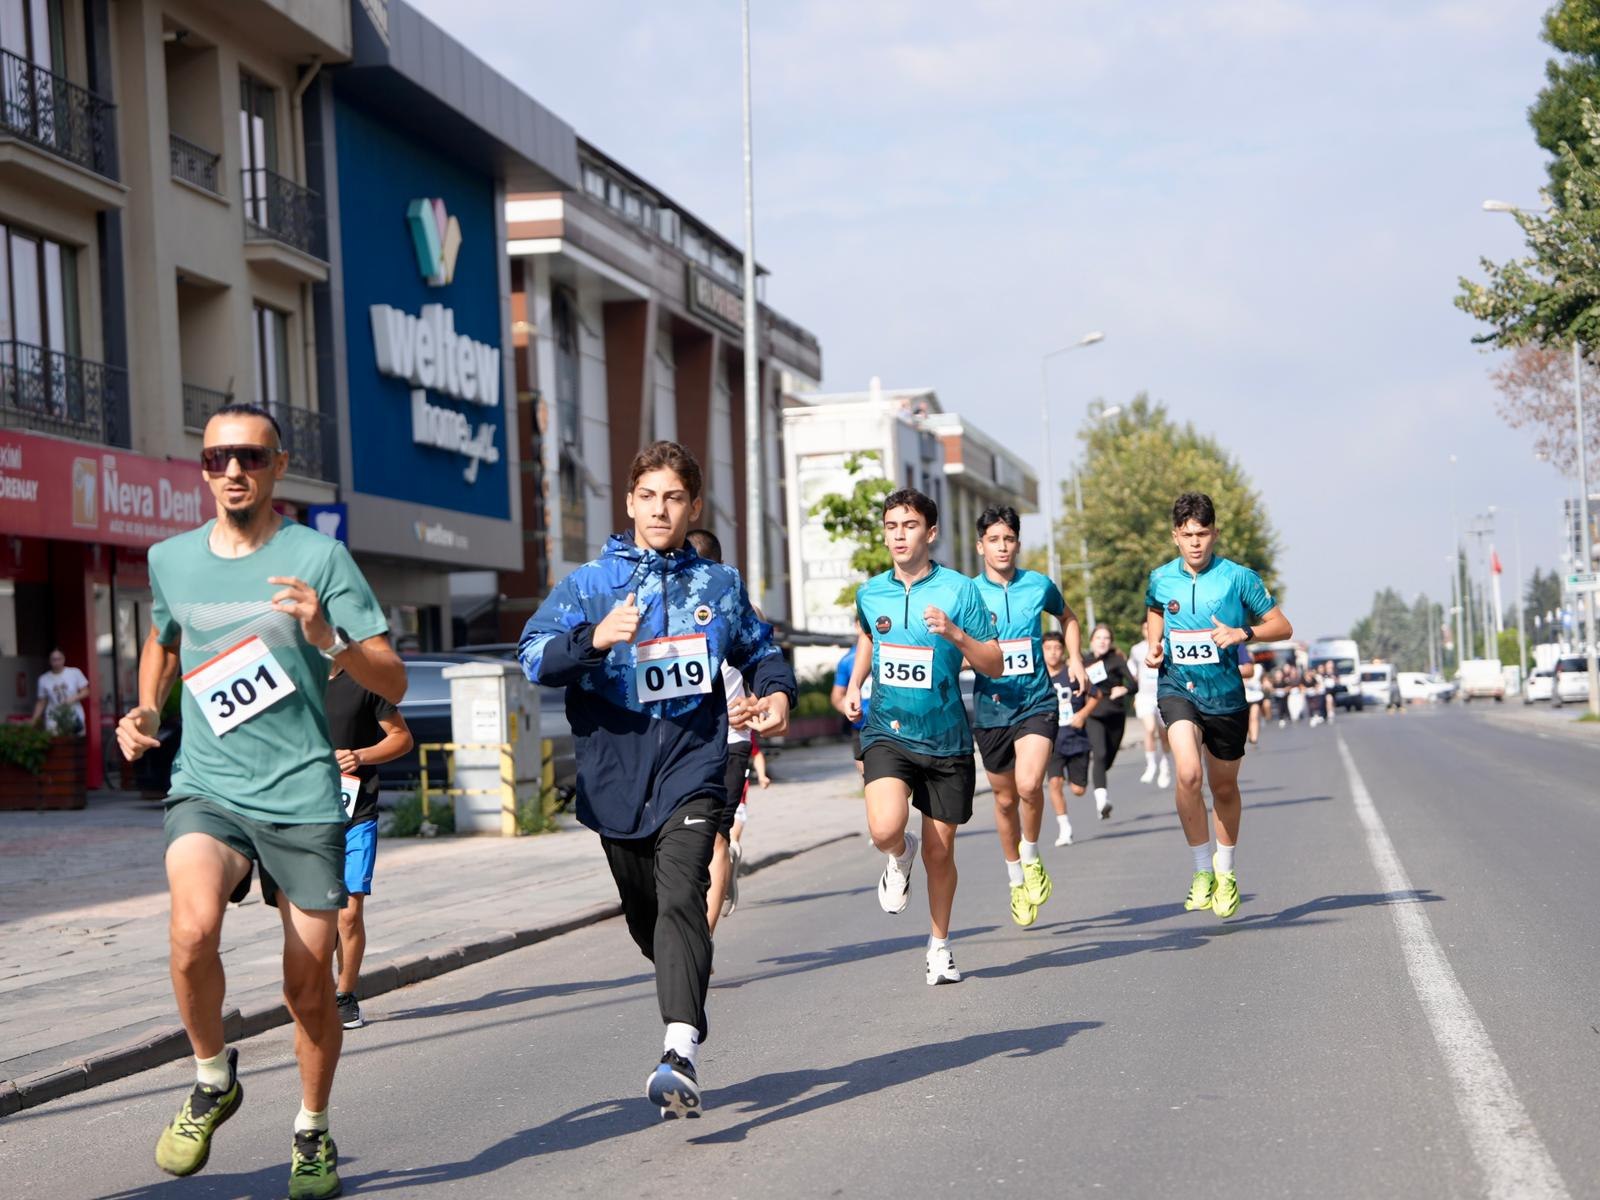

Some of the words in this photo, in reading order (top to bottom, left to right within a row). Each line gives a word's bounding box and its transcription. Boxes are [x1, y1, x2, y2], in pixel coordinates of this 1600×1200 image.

[369, 303, 499, 406] weltew
[102, 468, 155, 519] Neva
[158, 477, 202, 523] Dent
[1004, 654, 1028, 670] 13
[1175, 644, 1213, 660] 343
[645, 660, 704, 692] 019
[884, 661, 926, 682] 356
[210, 664, 278, 718] 301
